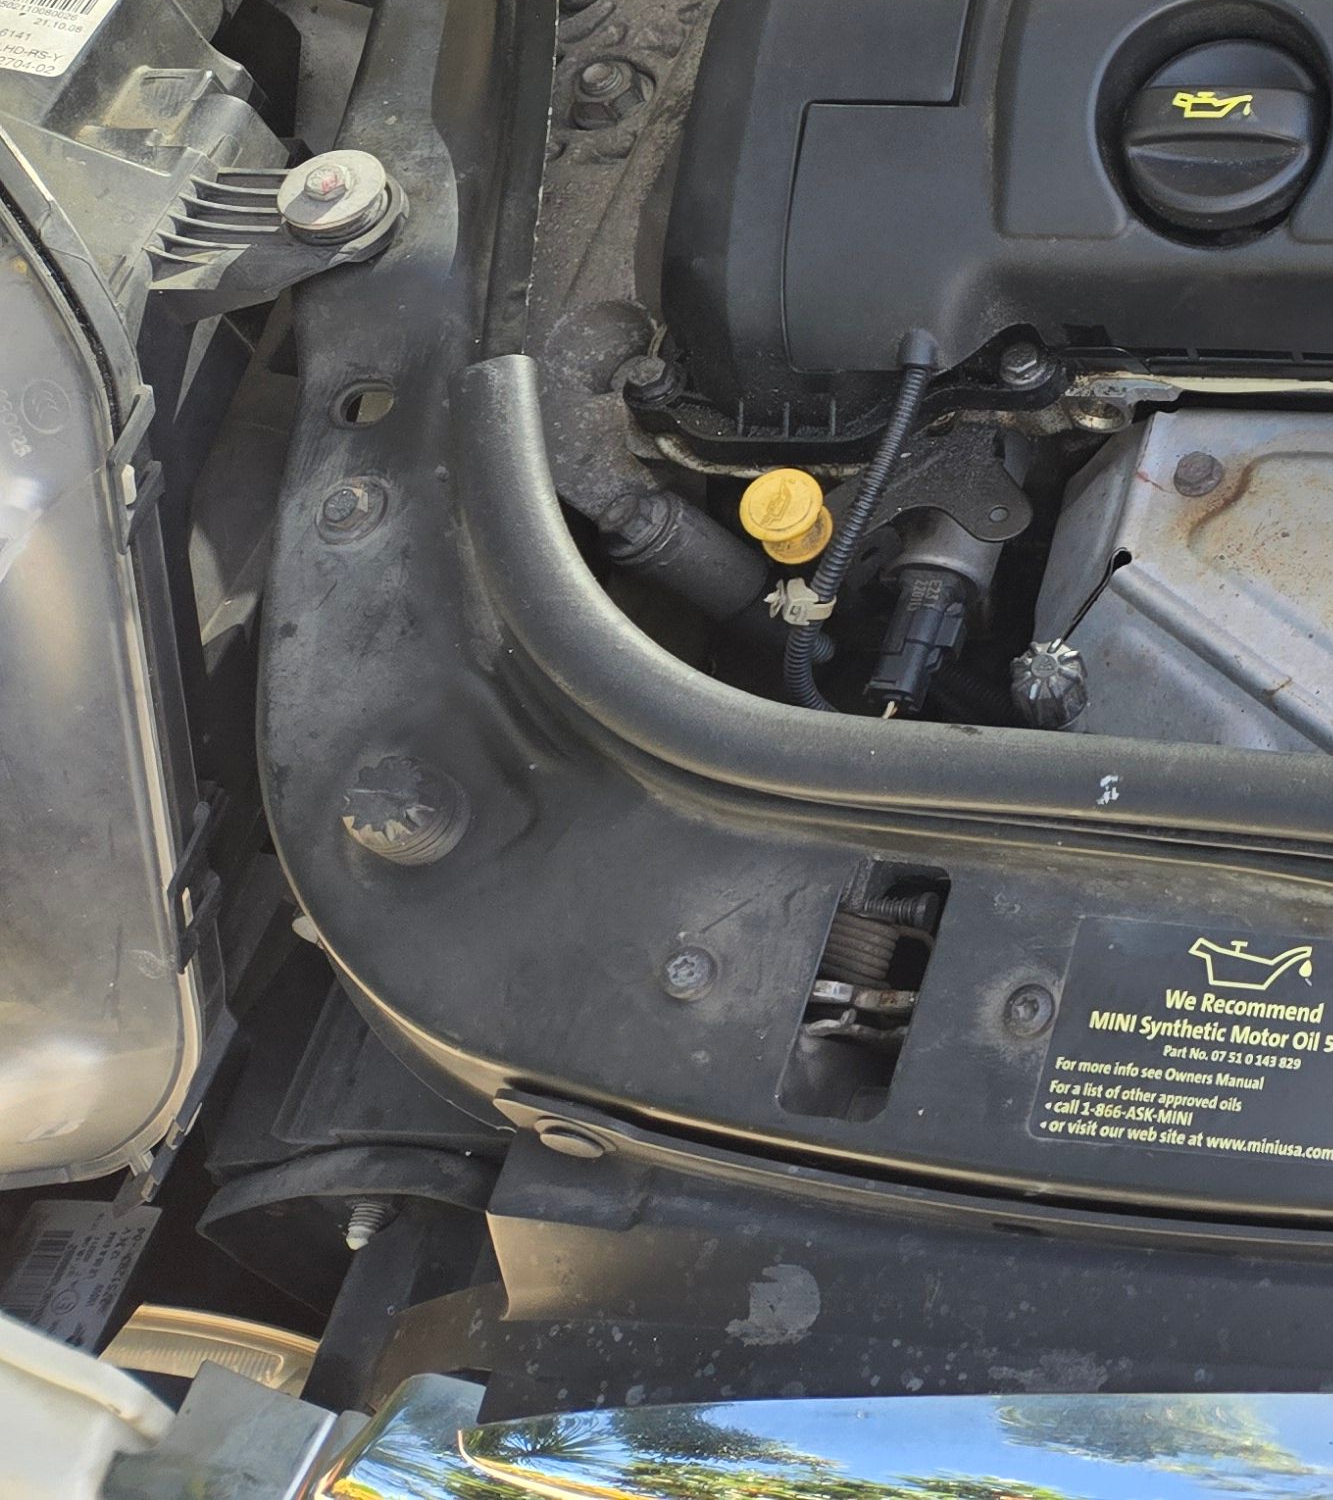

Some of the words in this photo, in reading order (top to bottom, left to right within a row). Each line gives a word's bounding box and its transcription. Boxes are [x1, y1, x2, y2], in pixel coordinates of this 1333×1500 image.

[0, 44, 64, 62] HD-RS-Y
[1165, 988, 1196, 1010] We
[1200, 992, 1324, 1023] Recommend
[1088, 1010, 1137, 1032] MINI
[1138, 1015, 1227, 1042] Synthetic
[1229, 1024, 1289, 1048] Motor
[1292, 1031, 1321, 1051] Oil
[1162, 1044, 1187, 1059] Part
[1188, 1047, 1208, 1060] No.
[1210, 1049, 1227, 1062] 07
[1227, 1051, 1242, 1064] 51
[1244, 1053, 1253, 1065] 0
[1254, 1054, 1277, 1067] 143
[1277, 1056, 1301, 1070] 829
[1055, 1056, 1077, 1071] For
[1077, 1061, 1111, 1074] more
[1113, 1061, 1139, 1077] info
[1140, 1067, 1162, 1080] see
[1164, 1067, 1213, 1085] Owners
[1215, 1072, 1264, 1090] Manual
[1049, 1079, 1071, 1094] For
[1071, 1084, 1081, 1095] a
[1082, 1082, 1103, 1098] list
[1104, 1085, 1120, 1099] of
[1119, 1085, 1157, 1102] other
[1157, 1093, 1218, 1109] approved
[1219, 1097, 1242, 1112] oils
[1053, 1099, 1080, 1114] call
[1080, 1101, 1193, 1126] 1-866-ASK-MINI
[1048, 1120, 1066, 1132] or
[1067, 1119, 1098, 1136] visit
[1099, 1125, 1125, 1138] our
[1127, 1126, 1157, 1142] web
[1158, 1128, 1186, 1144] site
[1187, 1131, 1203, 1147] at
